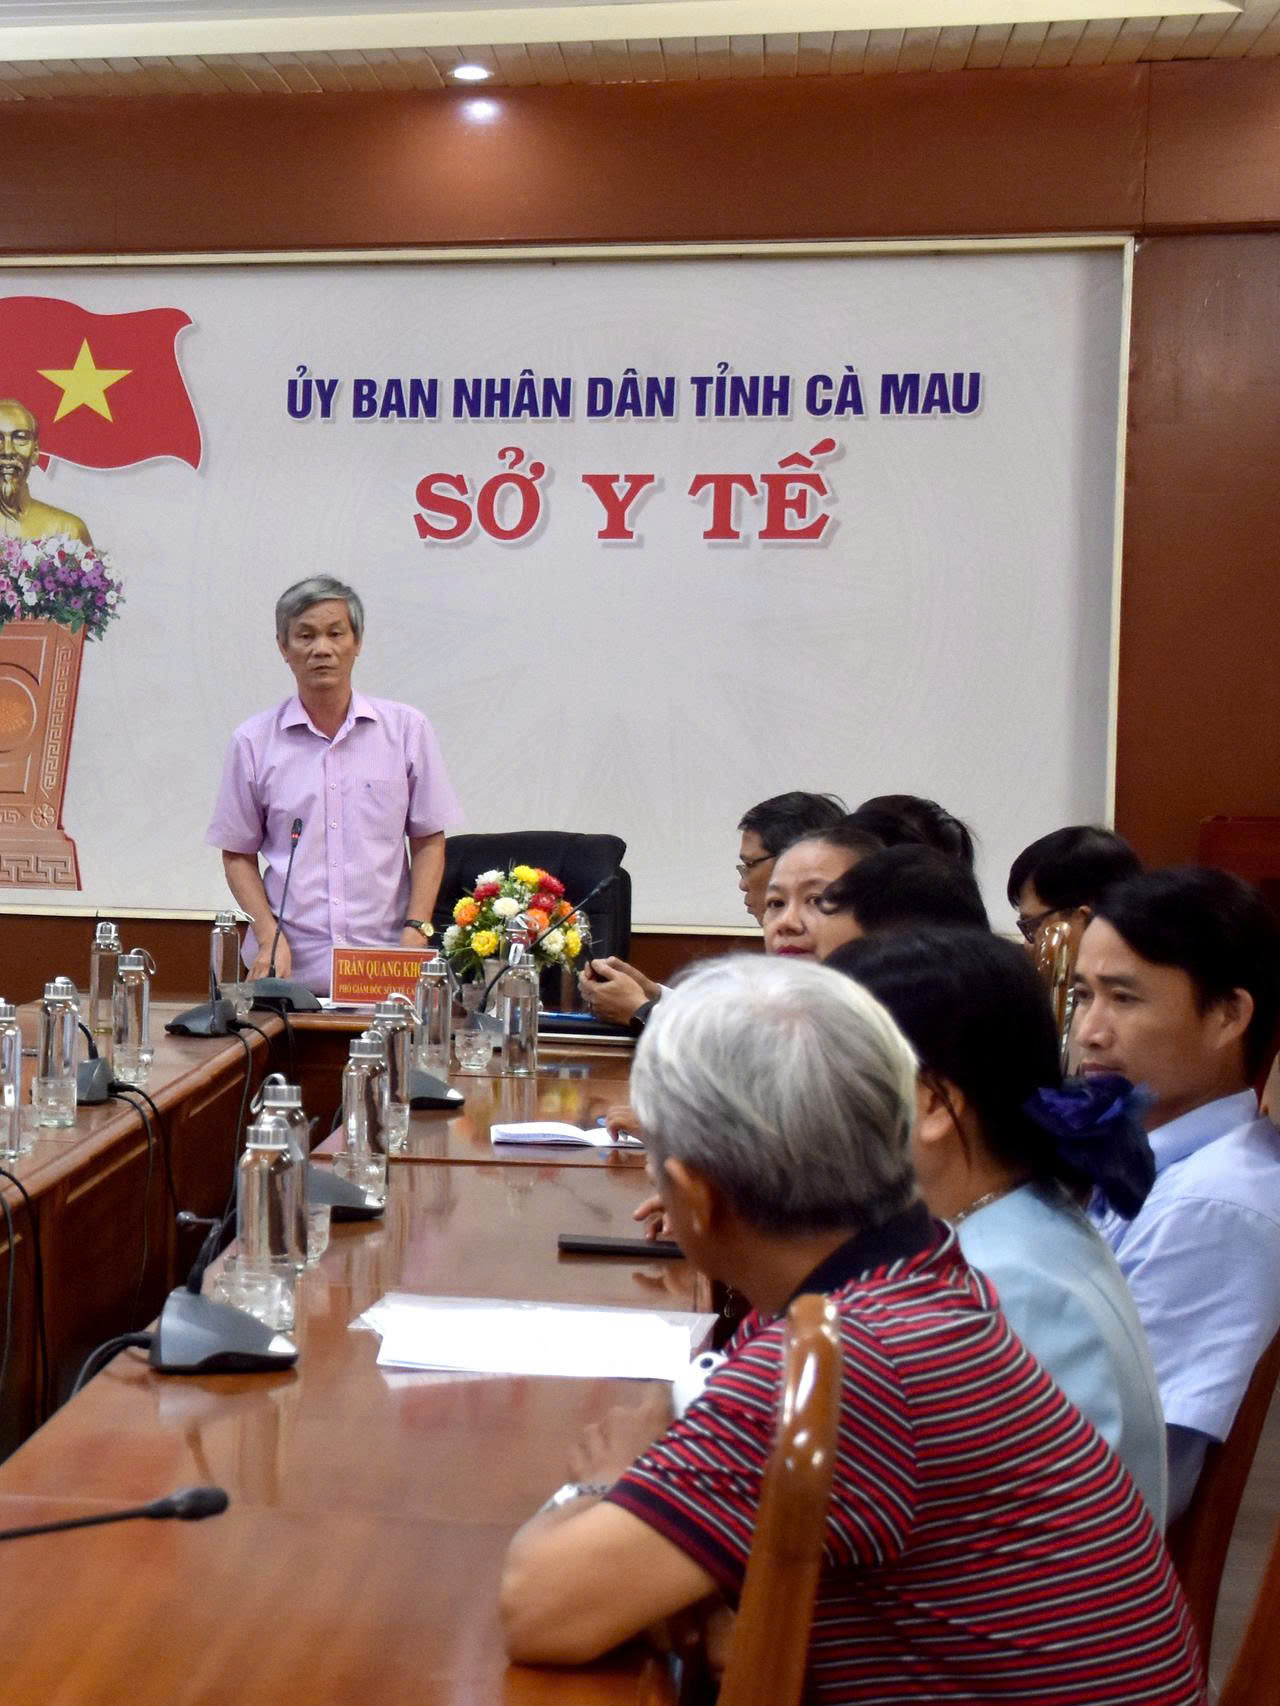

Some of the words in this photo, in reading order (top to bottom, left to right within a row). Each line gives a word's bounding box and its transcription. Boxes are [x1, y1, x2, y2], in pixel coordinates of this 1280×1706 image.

[287, 365, 339, 419] ỦY
[352, 378, 438, 418] BAN
[453, 368, 571, 418] NHÂN
[586, 367, 676, 417] DÂN
[690, 361, 790, 416] TỈNH
[806, 365, 864, 416] CÀ
[880, 372, 981, 415] MAU
[413, 446, 545, 541] SỞ
[581, 474, 655, 540] Y
[687, 437, 837, 540] TẾ
[366, 959, 401, 979] QUANG
[403, 957, 422, 978] KH
